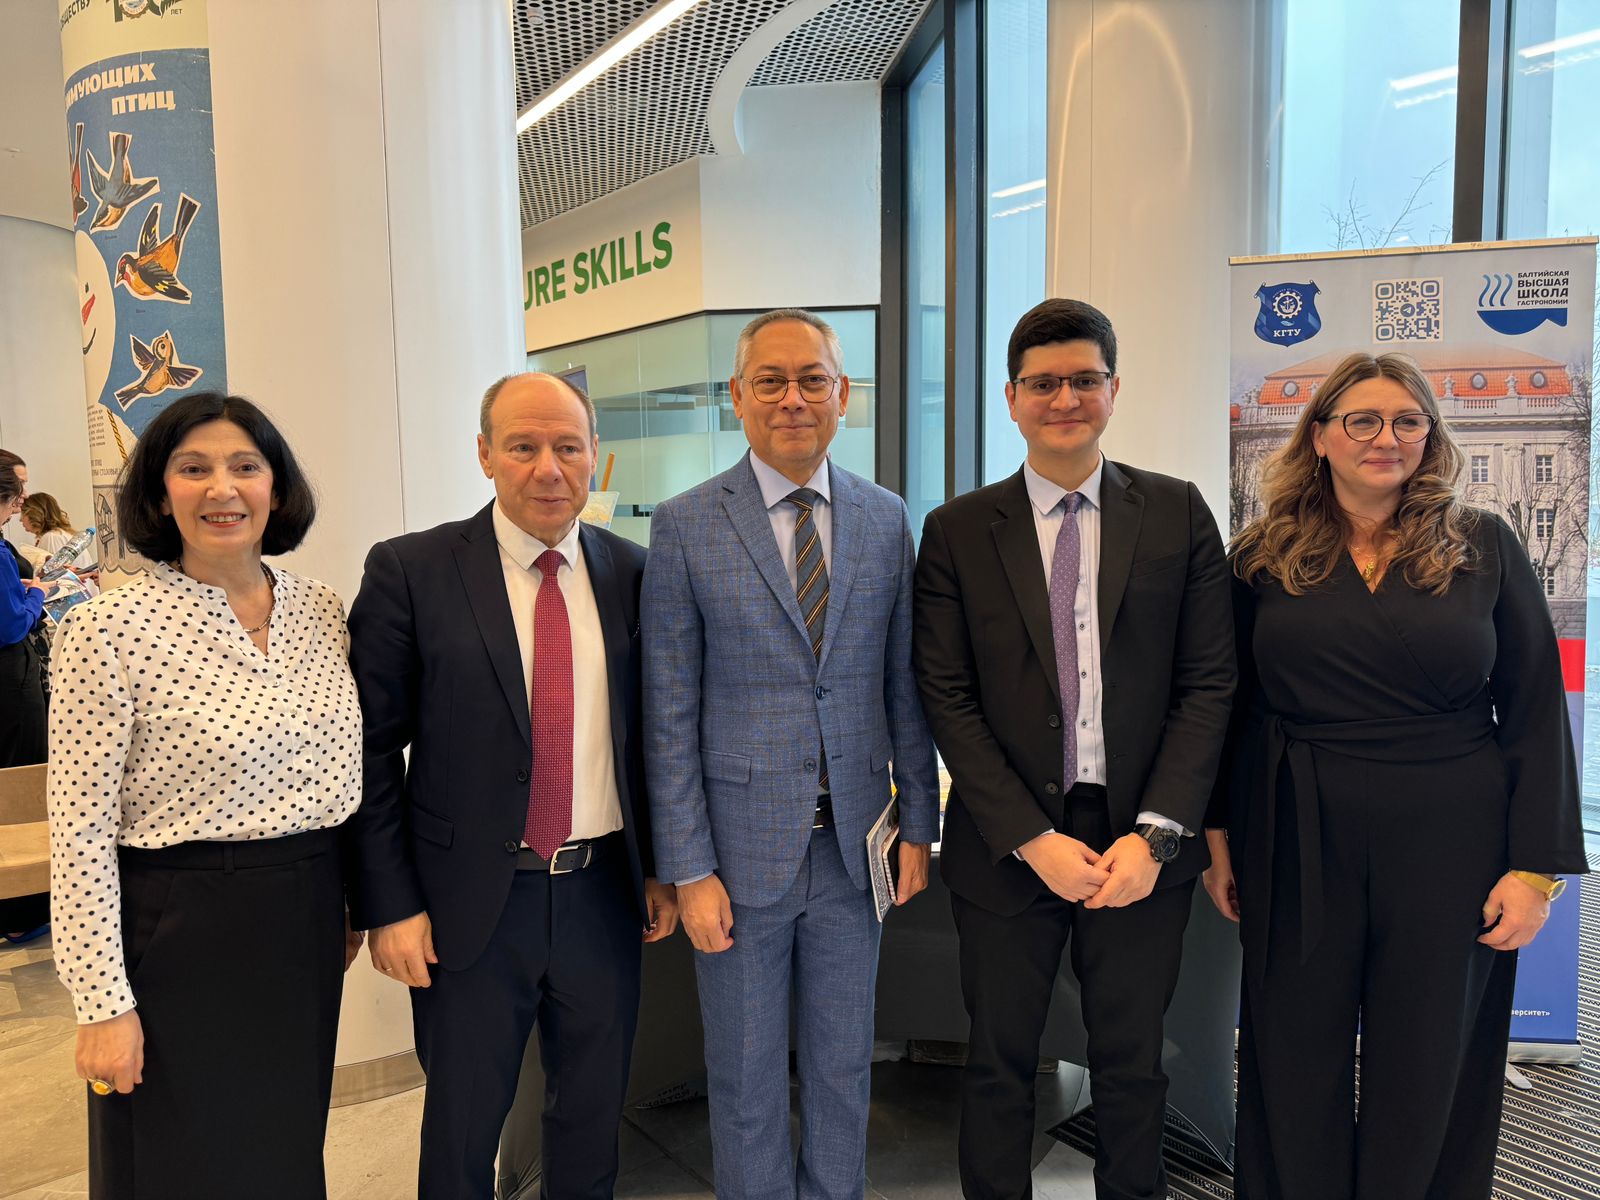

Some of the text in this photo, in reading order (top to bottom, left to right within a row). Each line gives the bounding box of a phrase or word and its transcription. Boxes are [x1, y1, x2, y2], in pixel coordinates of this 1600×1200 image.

[65, 62, 157, 112] ИМУЮЩИХ
[111, 90, 177, 116] ПТИЦ
[573, 221, 673, 295] SKILLS
[1517, 270, 1570, 278] БАЛТИЙСКАЯ
[1517, 278, 1569, 288] ВЫСШАЯ
[1517, 288, 1569, 299] ШКОЛА
[1273, 328, 1302, 338] КГТУ
